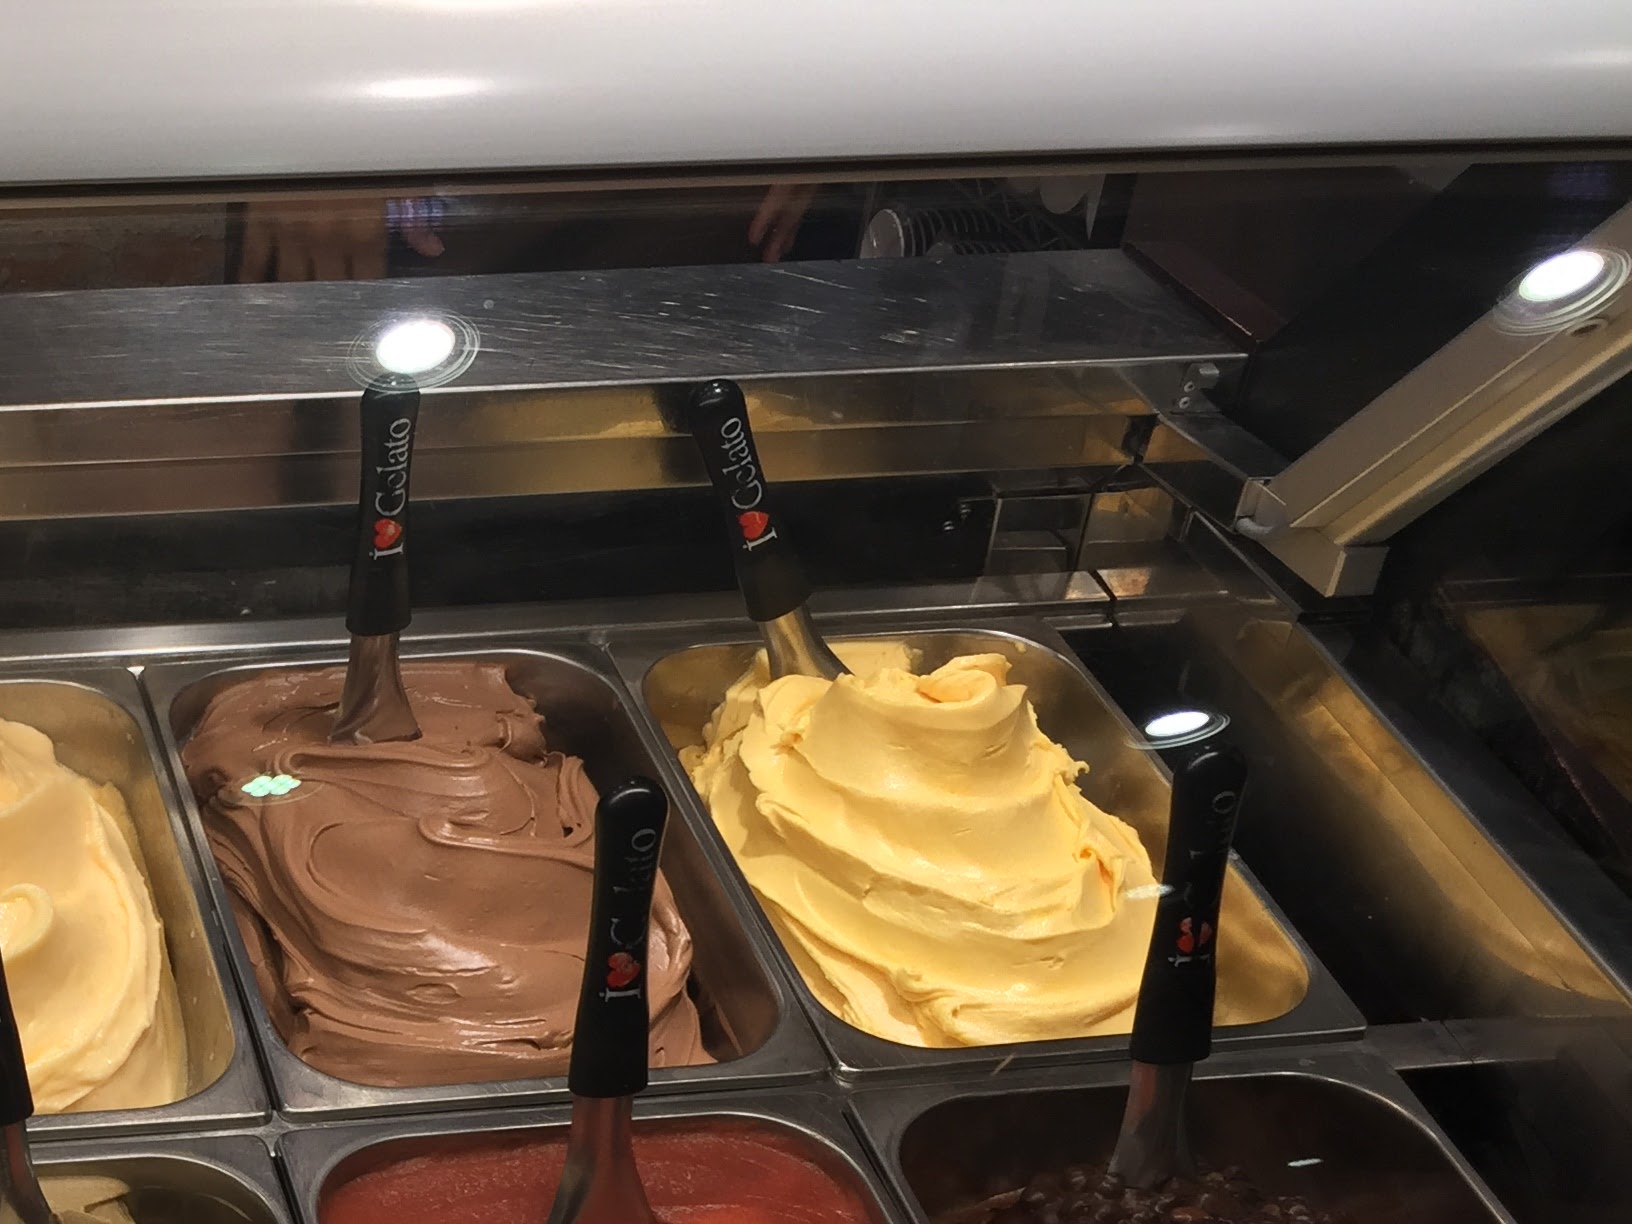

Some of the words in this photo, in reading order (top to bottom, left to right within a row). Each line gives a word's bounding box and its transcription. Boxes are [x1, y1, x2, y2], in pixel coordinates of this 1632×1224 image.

[374, 417, 412, 517] Gelato
[719, 417, 764, 510] Gelato
[609, 828, 658, 950] Glato
